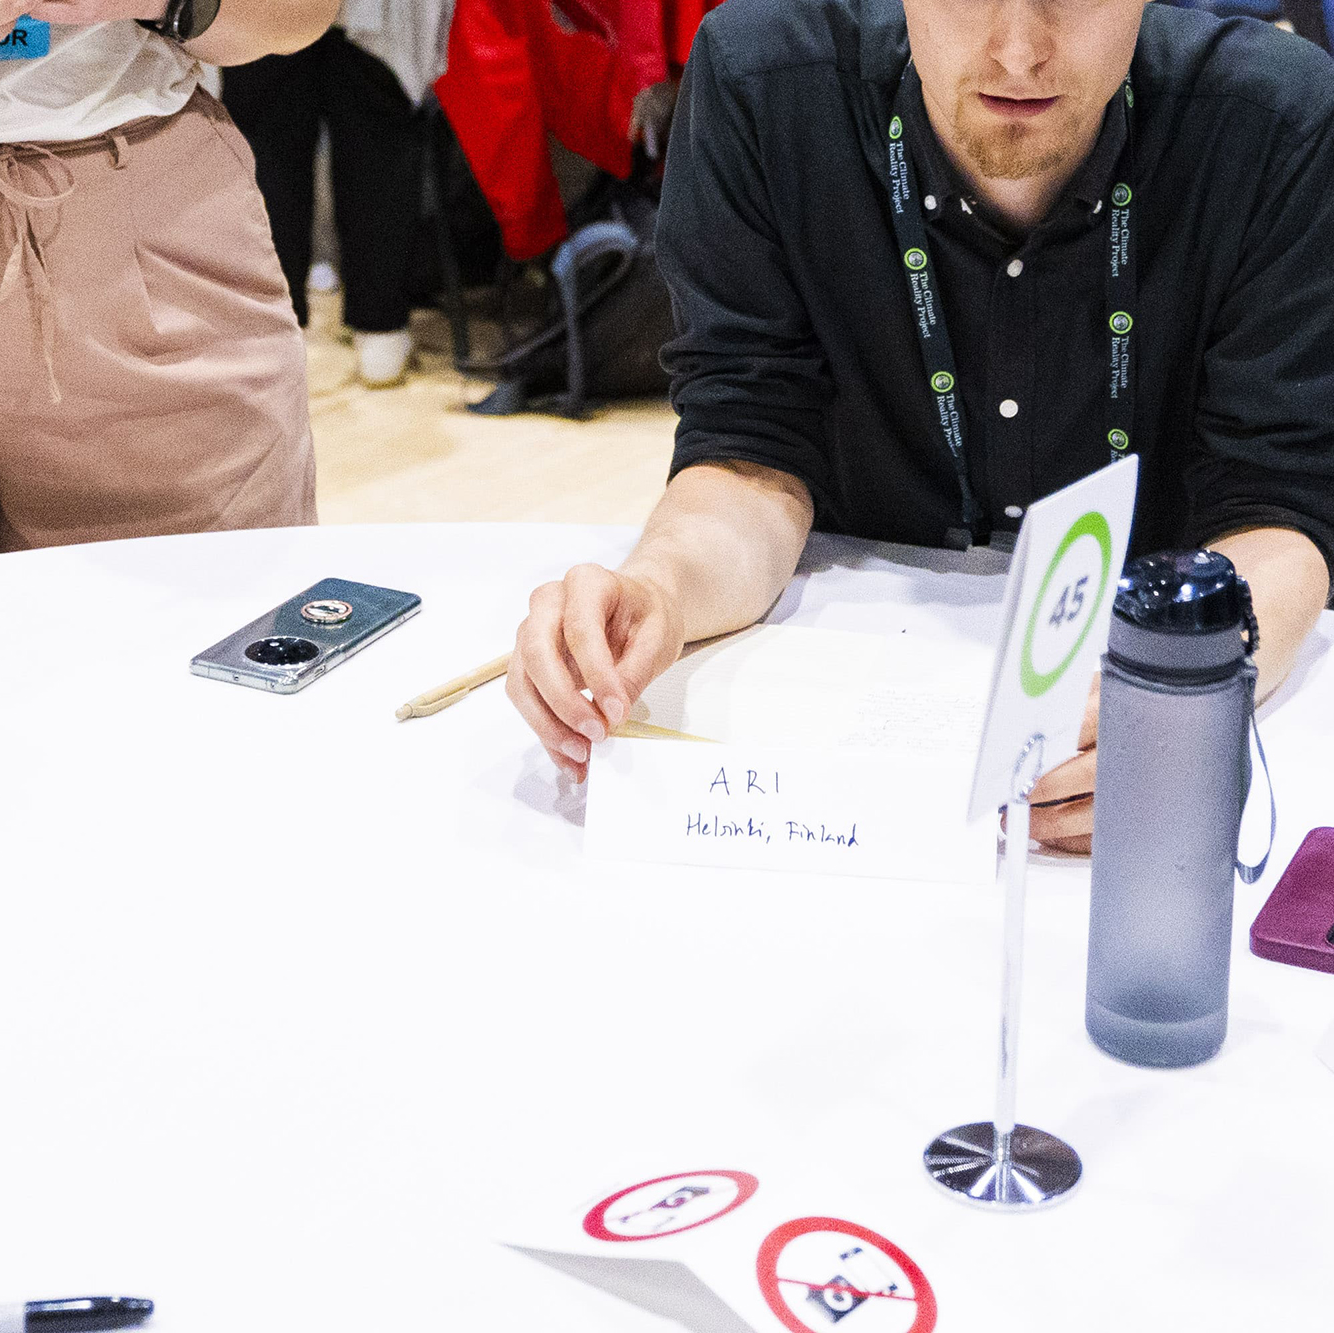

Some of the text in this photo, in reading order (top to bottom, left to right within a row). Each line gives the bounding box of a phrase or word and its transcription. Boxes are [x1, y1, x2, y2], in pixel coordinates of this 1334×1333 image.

[1110, 209, 1120, 277] Reality Project
[1121, 209, 1130, 265] The Climate
[910, 273, 931, 338] Reality Project
[919, 271, 937, 326] The Climate
[937, 395, 949, 426] Reality
[946, 393, 955, 410] The
[949, 411, 963, 447] Climate
[1048, 575, 1090, 630] 45
[709, 766, 780, 795] ARI
[686, 813, 860, 848] Helsinki, Finland
